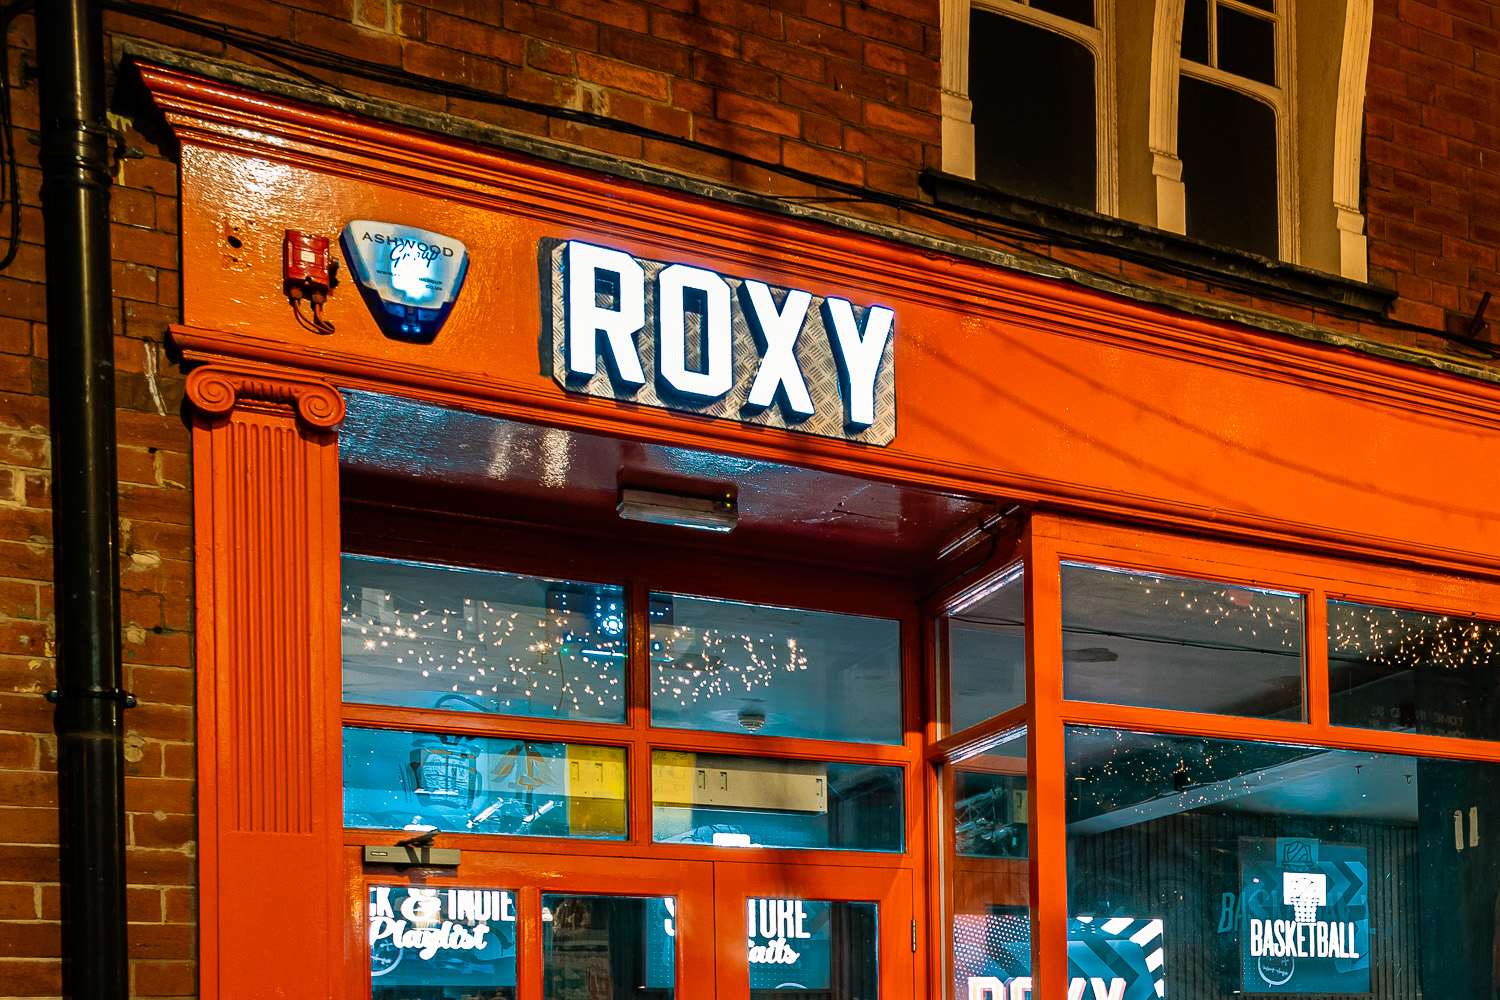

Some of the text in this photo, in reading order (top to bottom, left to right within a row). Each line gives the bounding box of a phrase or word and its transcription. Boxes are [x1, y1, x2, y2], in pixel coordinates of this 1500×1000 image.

[362, 231, 454, 258] ASHWOOD
[569, 239, 896, 429] ROXY
[448, 888, 516, 921] INDIE
[370, 917, 490, 960] Playlist
[1250, 918, 1360, 959] BASKETBALL
